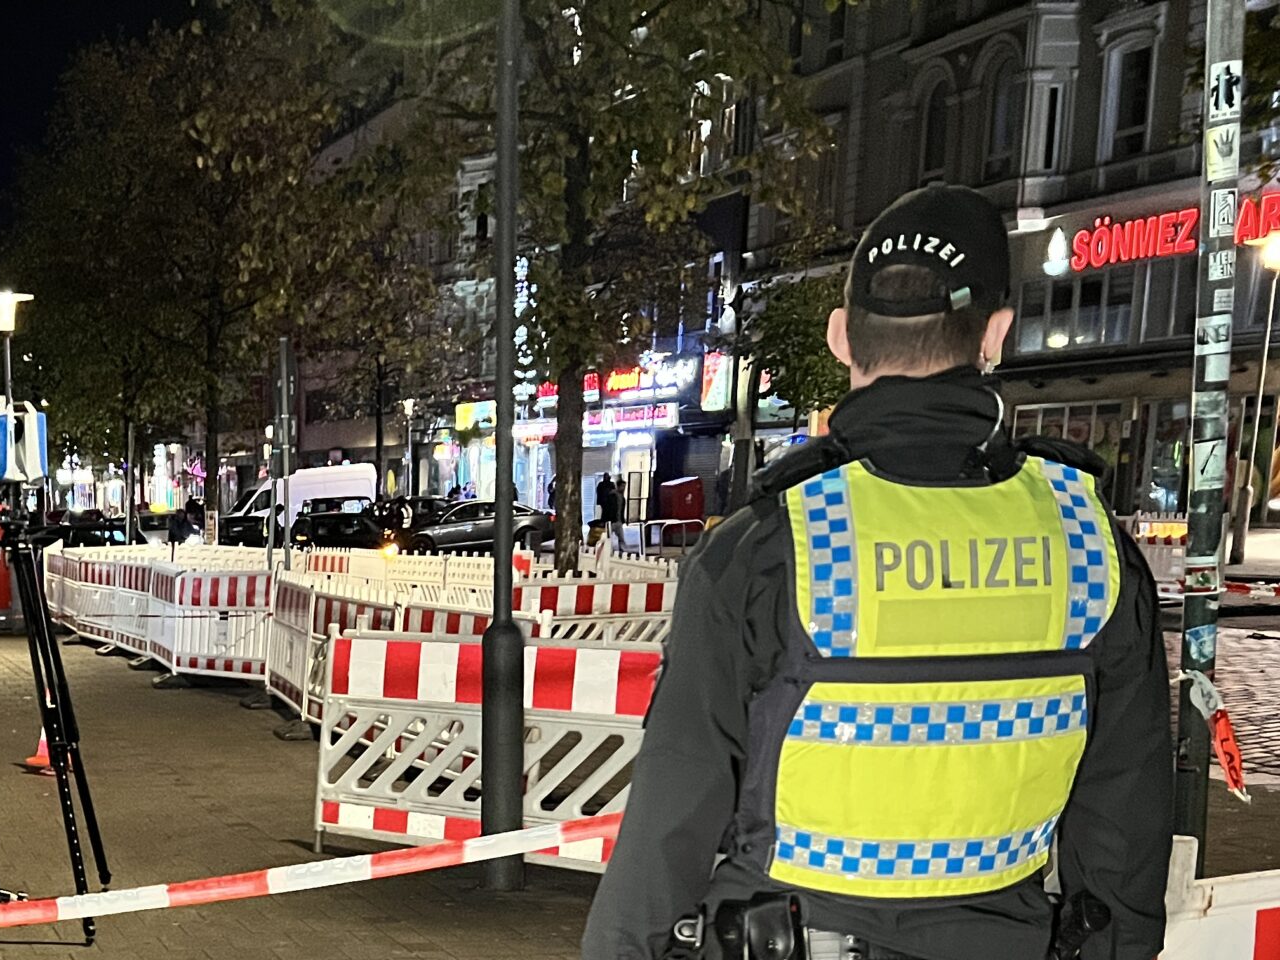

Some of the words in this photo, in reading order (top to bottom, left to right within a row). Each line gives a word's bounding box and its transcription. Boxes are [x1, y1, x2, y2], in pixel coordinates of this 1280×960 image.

[868, 233, 966, 268] POLIZEI
[1070, 208, 1200, 272] SÖNMEZ
[874, 536, 1052, 592] POLIZEI
